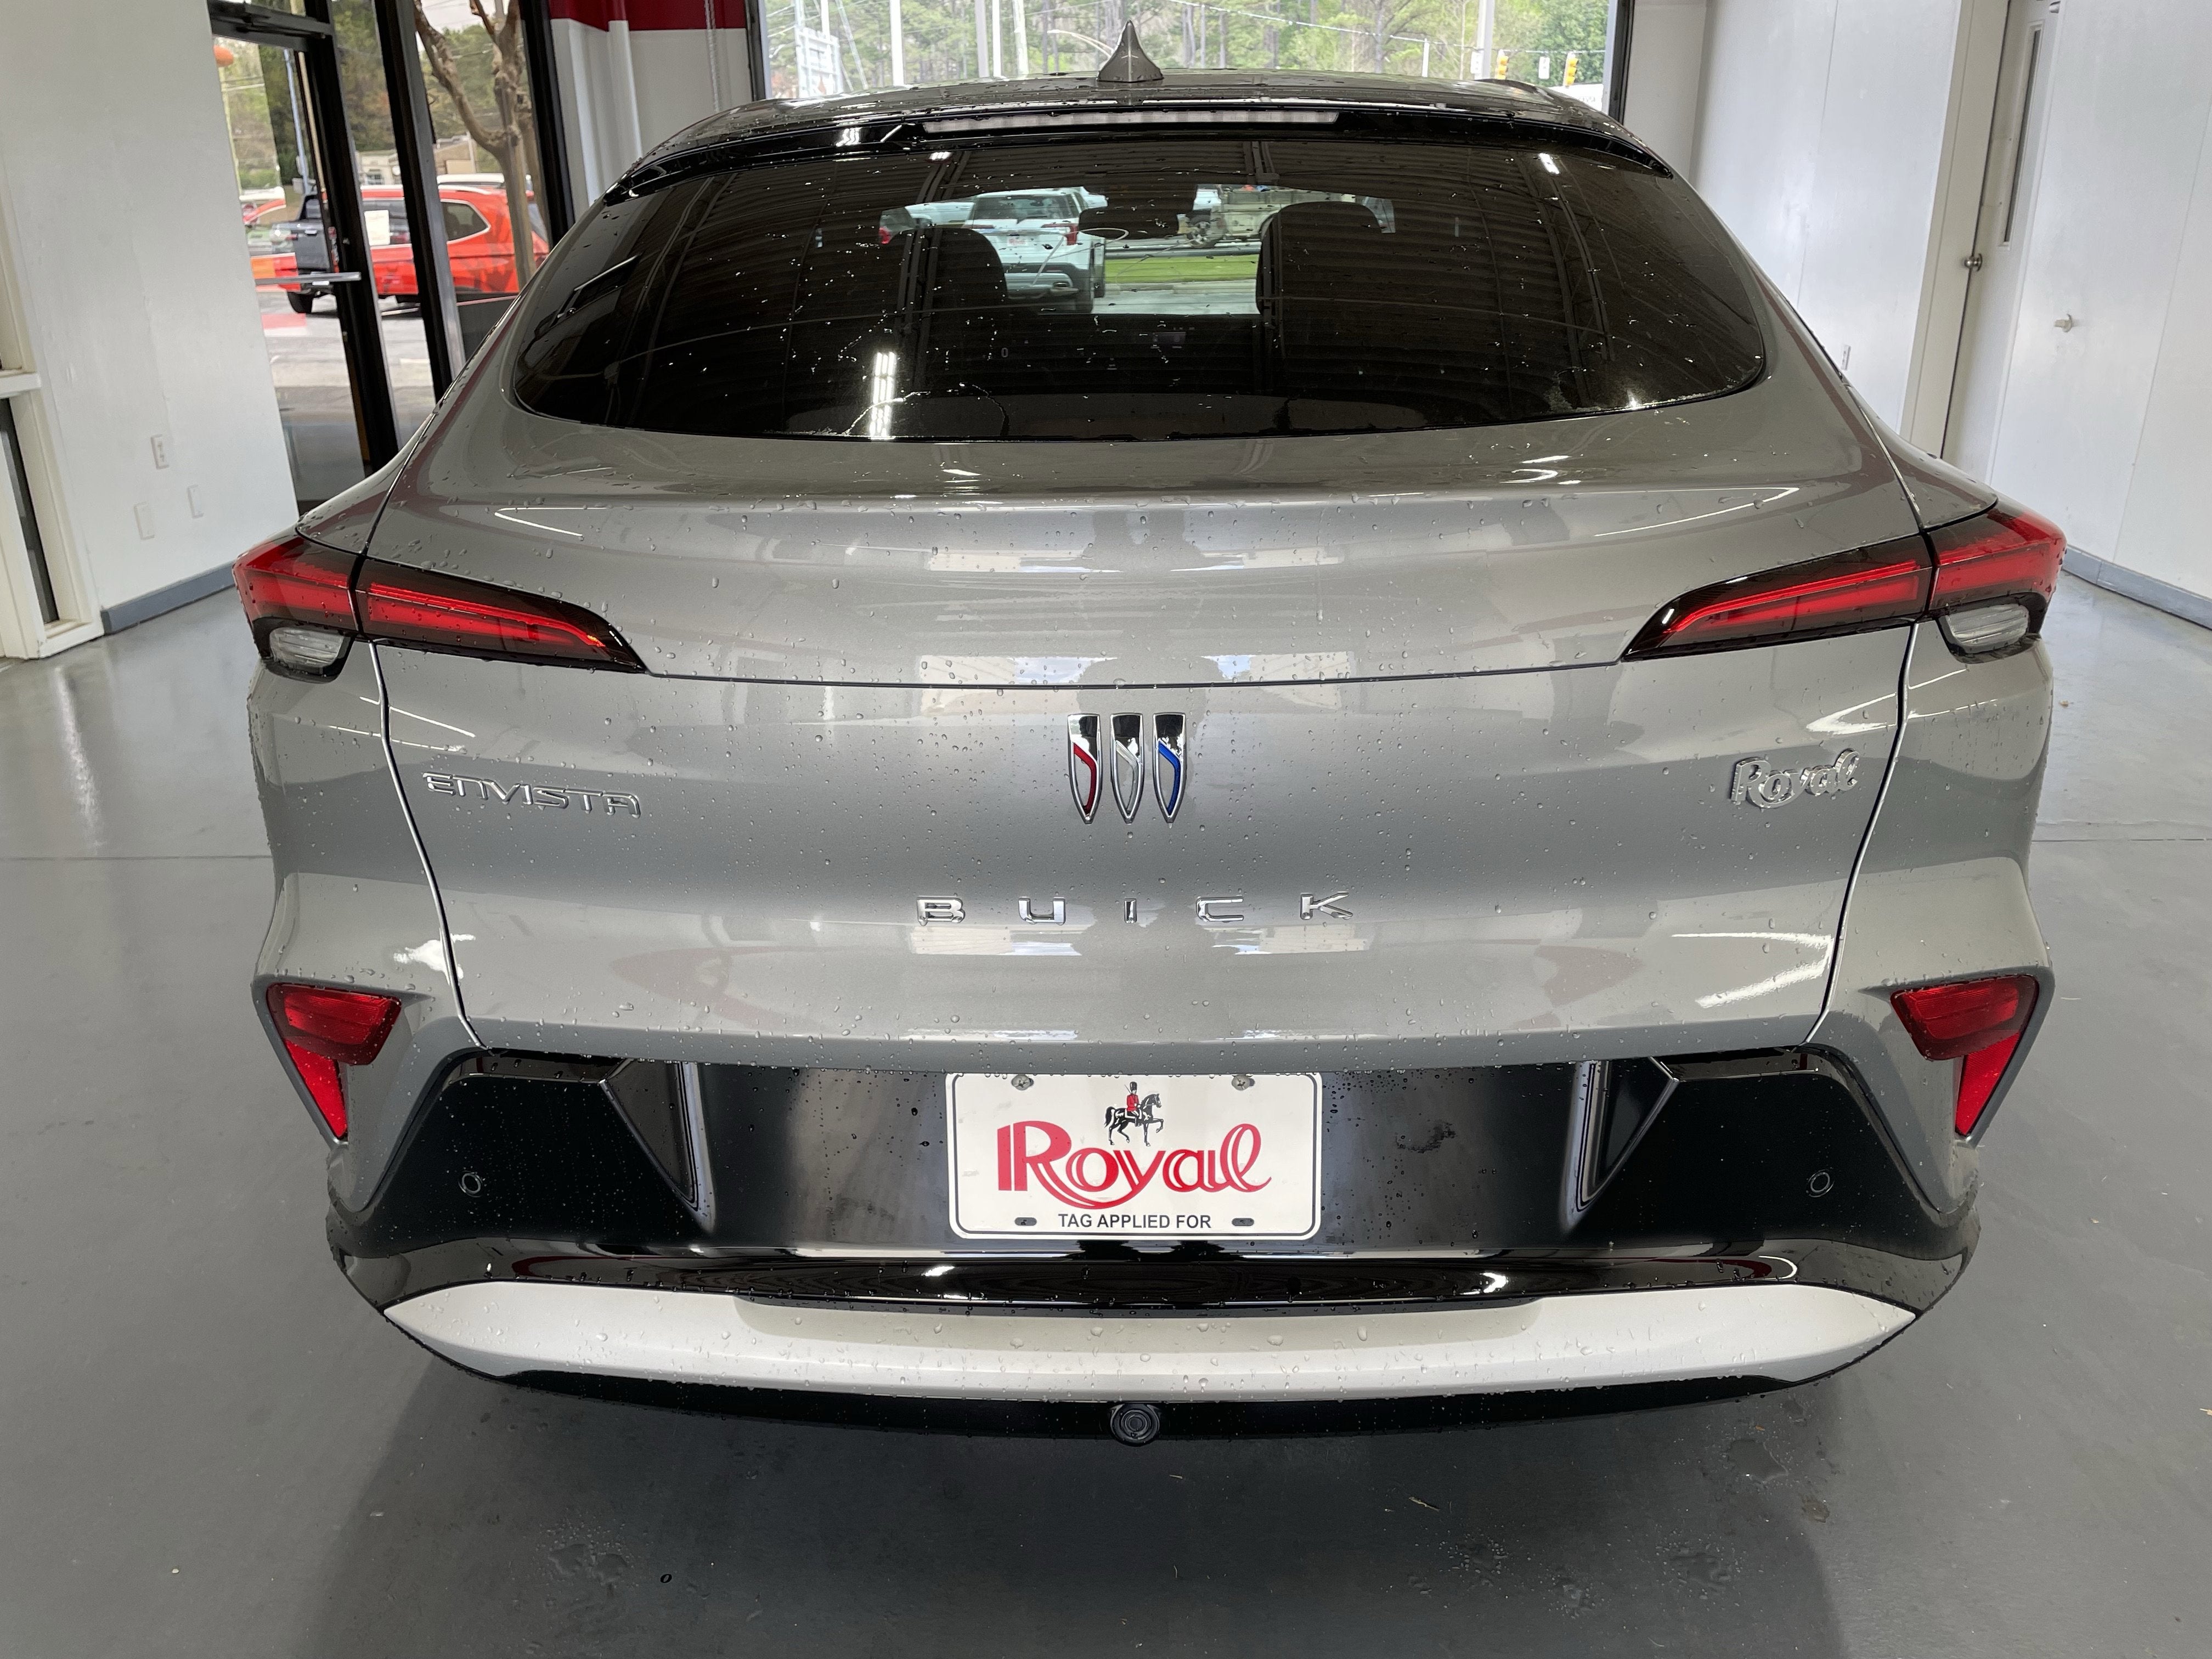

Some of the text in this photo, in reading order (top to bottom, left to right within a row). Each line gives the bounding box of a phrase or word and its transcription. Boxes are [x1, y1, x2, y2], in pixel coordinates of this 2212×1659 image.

[422, 771, 641, 818] ENVISTA
[1730, 748, 1860, 809] Royal
[917, 891, 1353, 926] BUICK
[997, 1120, 1272, 1210] Royal
[1058, 1213, 1212, 1229] TAG APPLIED FOR
